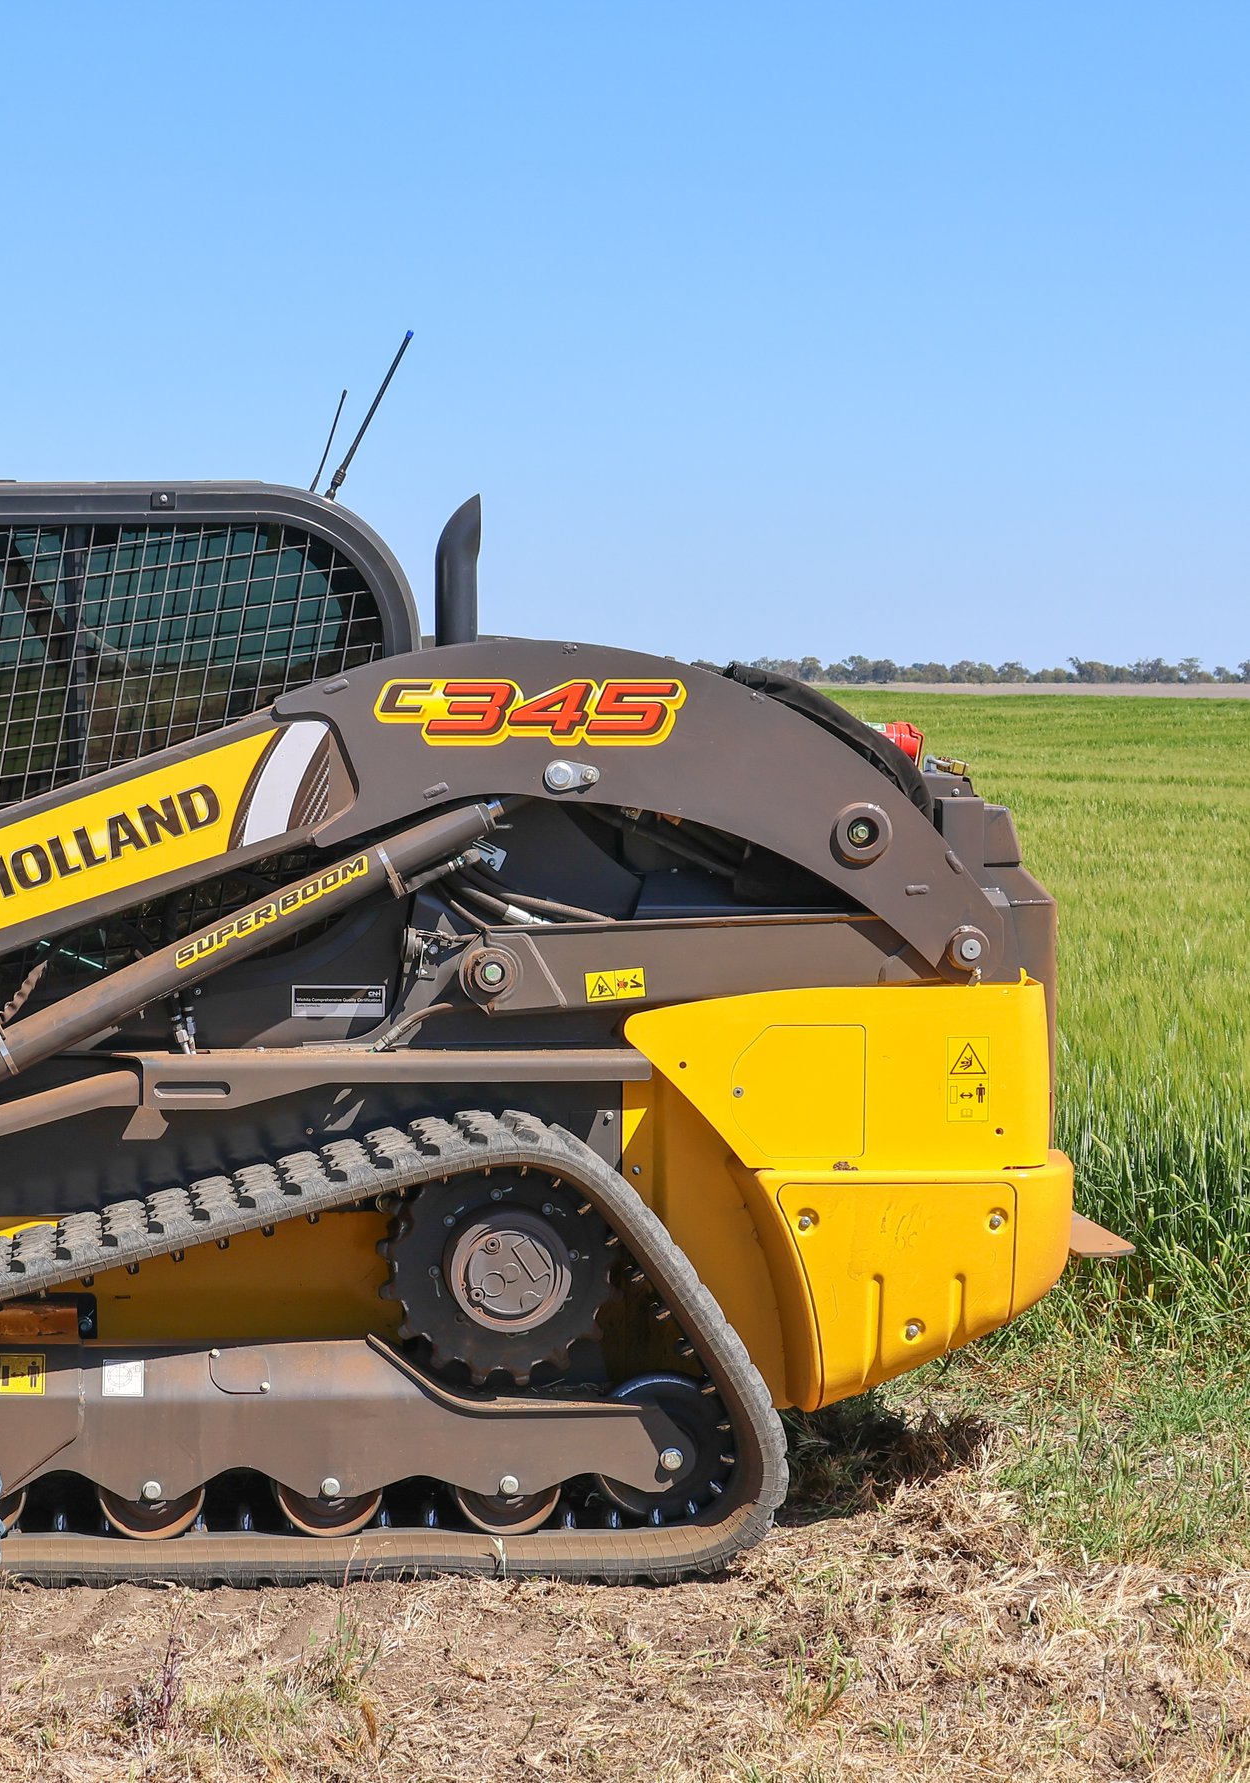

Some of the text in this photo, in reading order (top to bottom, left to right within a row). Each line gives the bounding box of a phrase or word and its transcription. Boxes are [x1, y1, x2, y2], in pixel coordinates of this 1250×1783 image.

[375, 678, 686, 746] C345
[176, 855, 368, 968] SUPER BOOM
